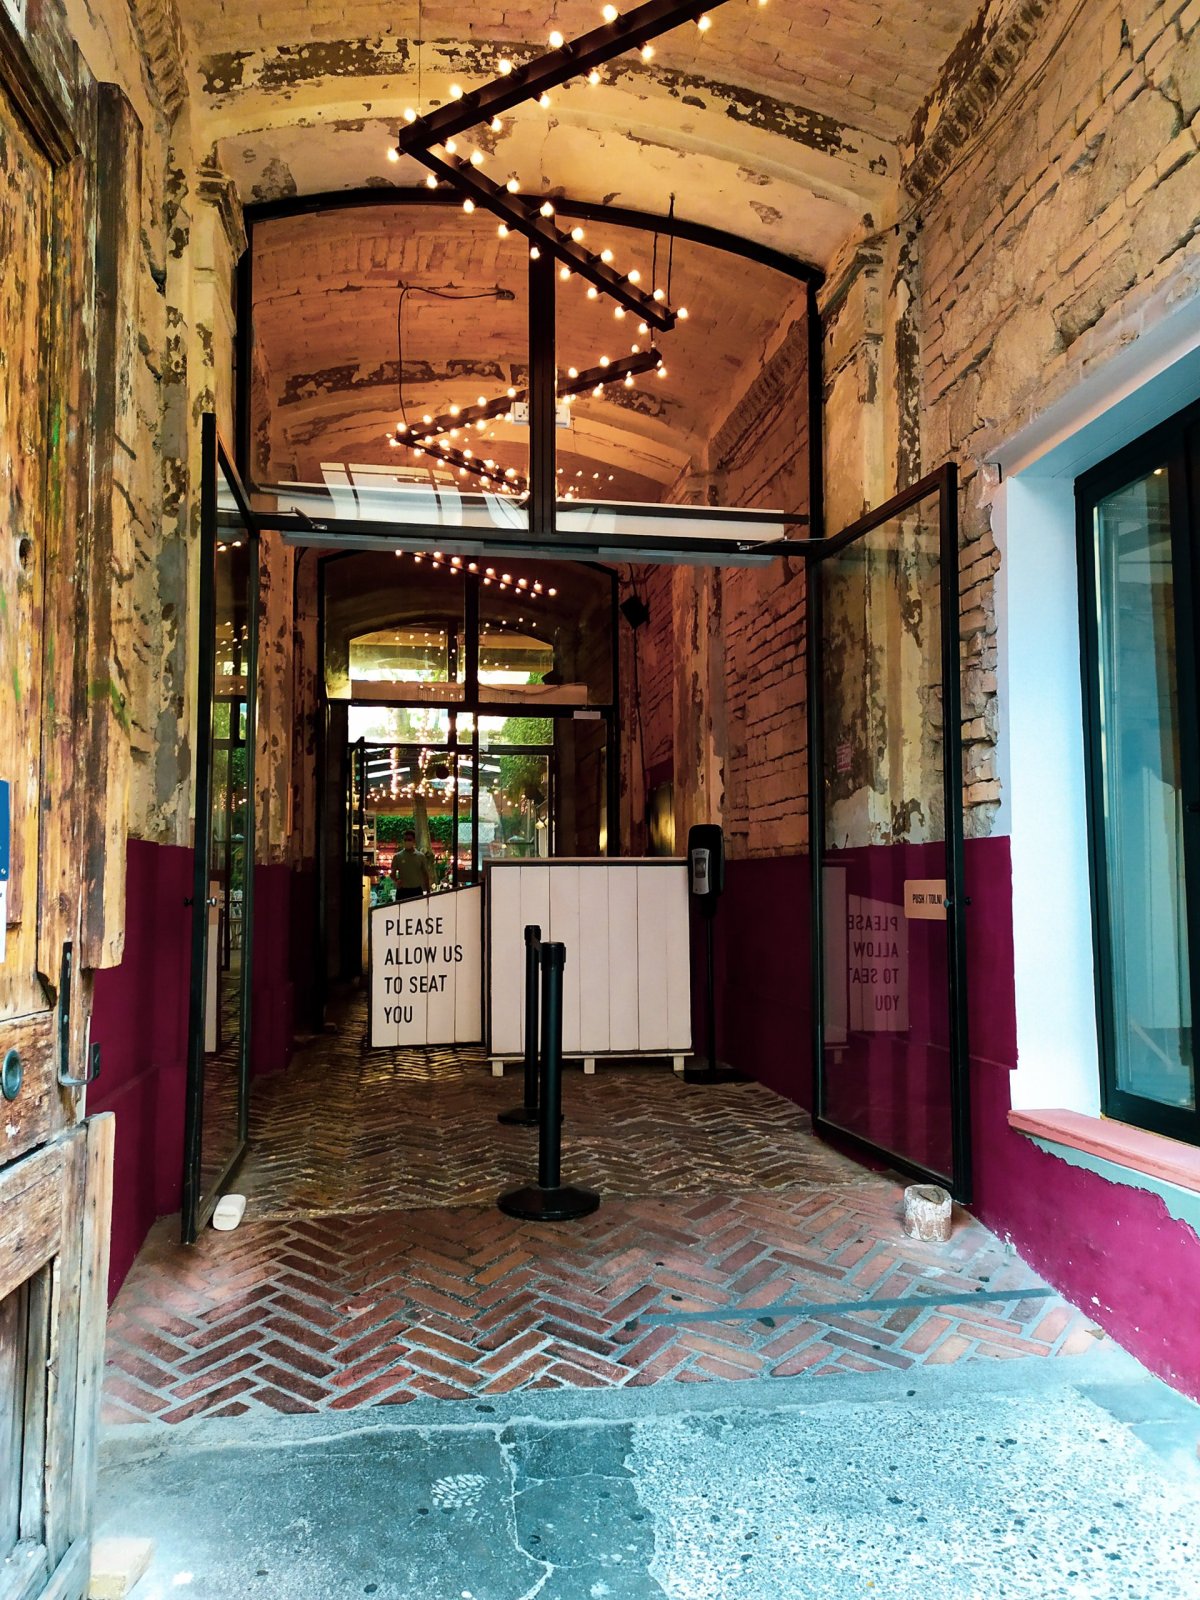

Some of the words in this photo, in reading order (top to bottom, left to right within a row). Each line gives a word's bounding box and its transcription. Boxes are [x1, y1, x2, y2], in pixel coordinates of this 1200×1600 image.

[912, 894, 925, 904] PUSH
[385, 917, 443, 936] PLEASE
[384, 946, 437, 965] ALLOW
[443, 945, 463, 962] US
[384, 976, 403, 994] TO
[409, 975, 447, 993] SEAT
[384, 1006, 413, 1024] YOU
